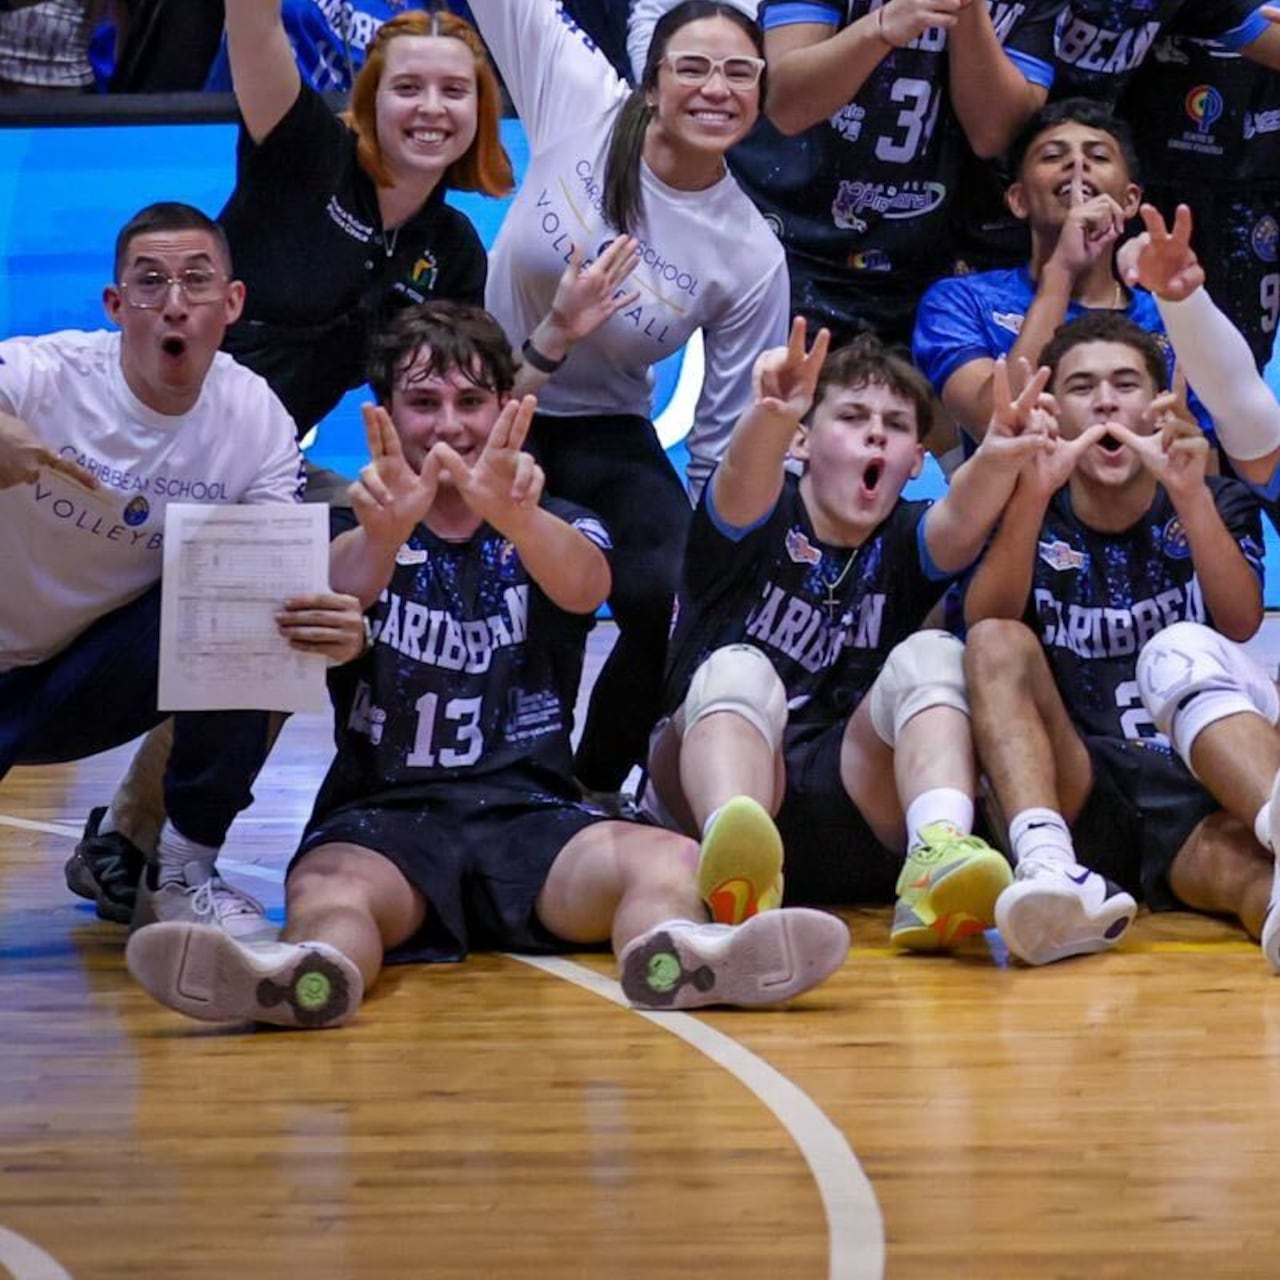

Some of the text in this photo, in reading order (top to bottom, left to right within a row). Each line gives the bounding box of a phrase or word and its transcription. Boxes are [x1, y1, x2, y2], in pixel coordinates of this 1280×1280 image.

[635, 240, 700, 298] SCHOOL
[1260, 272, 1280, 333] 9
[153, 476, 229, 501] SCHOOL
[406, 691, 485, 768] 13
